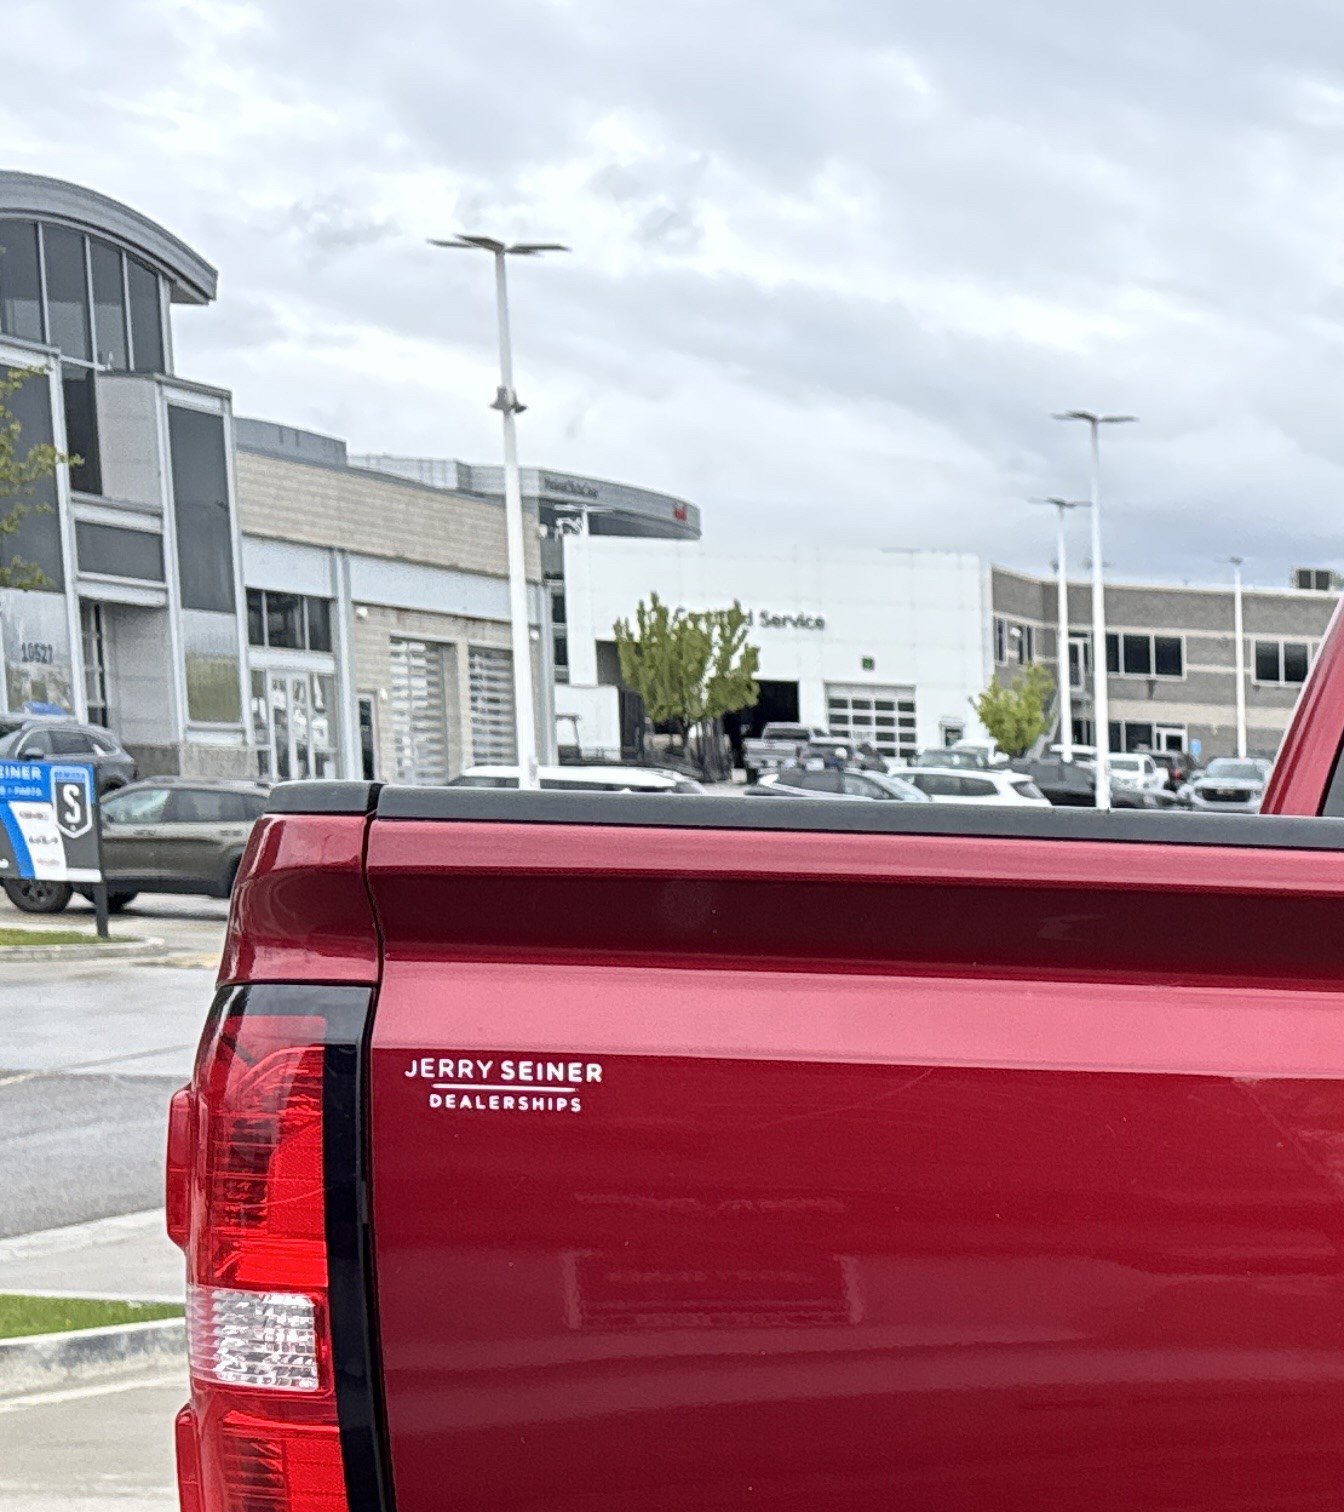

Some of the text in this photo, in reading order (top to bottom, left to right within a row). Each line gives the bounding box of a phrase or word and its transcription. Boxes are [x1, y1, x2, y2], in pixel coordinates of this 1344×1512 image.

[759, 610, 825, 630] Service
[62, 784, 80, 823] S
[404, 1057, 603, 1083] JERRY SEINER
[429, 1093, 582, 1113] DEALERSHIPS
